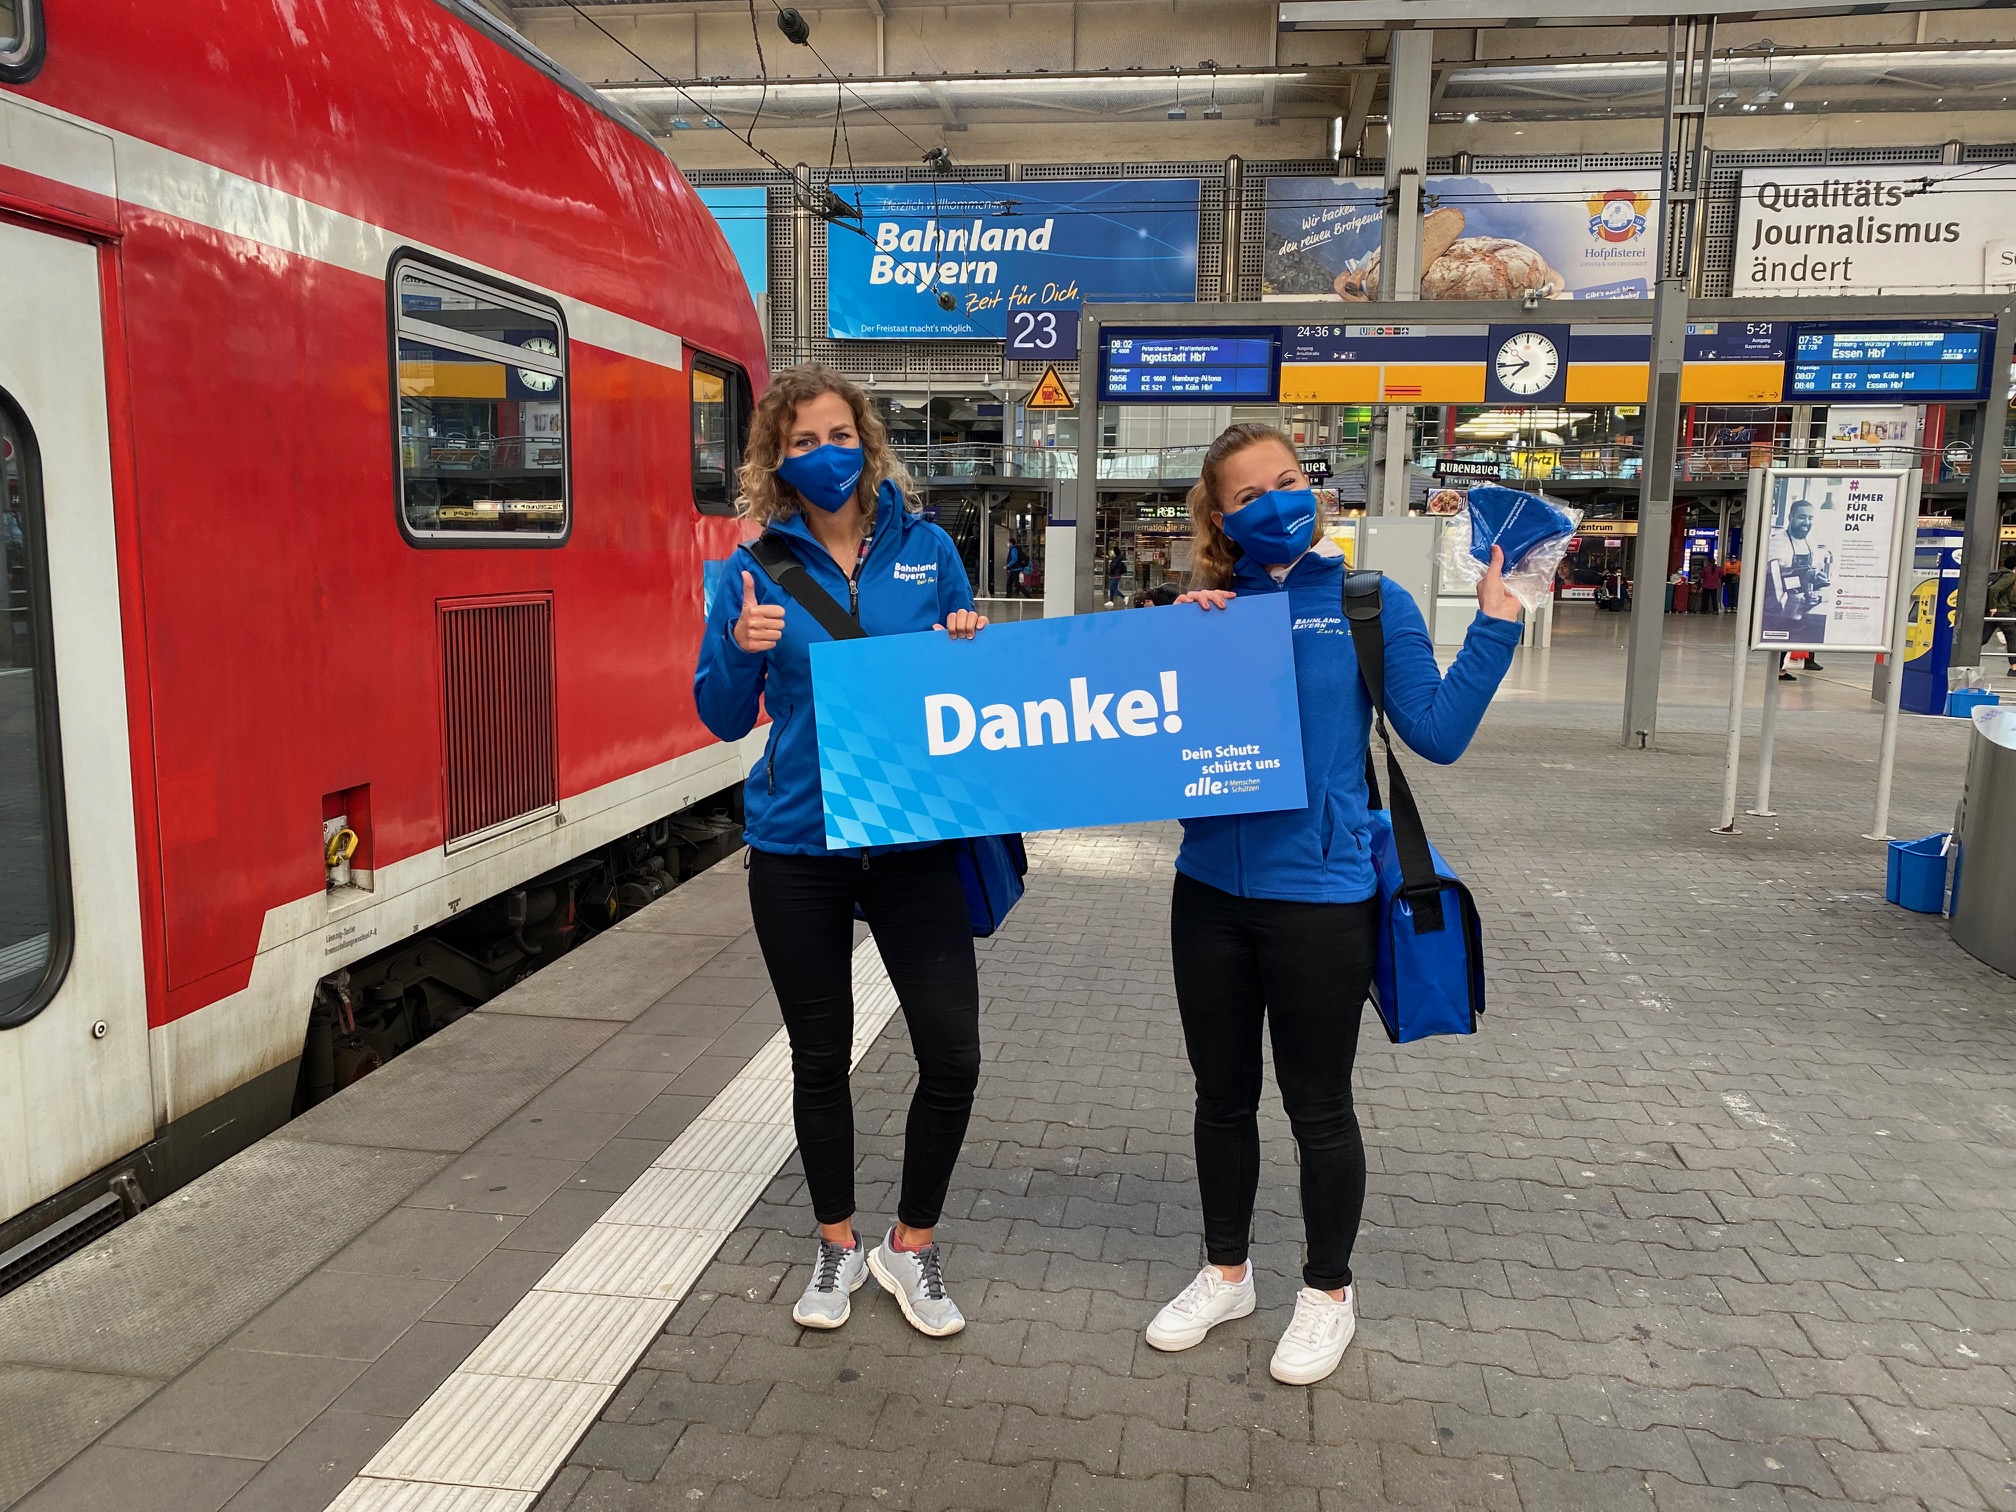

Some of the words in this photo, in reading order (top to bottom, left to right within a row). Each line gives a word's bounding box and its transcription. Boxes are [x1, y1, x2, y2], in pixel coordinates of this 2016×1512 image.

[882, 198, 924, 211] Herzlich
[926, 198, 991, 211] willkommen
[1302, 213, 1321, 230] Wir
[1322, 203, 1356, 223] backen
[874, 218, 1055, 253] Bahnland
[1752, 216, 1961, 250] Journalismus
[1278, 240, 1299, 256] den
[1300, 230, 1332, 248] reinen
[1585, 248, 1646, 260] Hofpfisterei
[2001, 250, 2016, 266] S
[868, 255, 999, 293] Bayern
[1751, 254, 1853, 283] ändert
[965, 290, 1003, 313] Zeit
[1007, 284, 1037, 311] für
[1041, 280, 1080, 305] Dich.
[861, 324, 875, 333] Der
[876, 323, 908, 333] Freistaat
[909, 323, 939, 333] macht's
[940, 323, 974, 335] möglich.
[1013, 312, 1058, 349] 23
[1297, 326, 1329, 337] 24-36
[1746, 323, 1773, 335] 5-21
[1111, 340, 1133, 349] 08:02
[1798, 335, 1823, 345] 07:52
[1141, 352, 1187, 364] Ingolstadt
[1190, 351, 1206, 362] Hbf
[1832, 349, 1863, 359] Essen
[1868, 347, 1886, 358] Hbf
[1172, 375, 1222, 384] Hamburg-Altona
[1795, 372, 1816, 380] 08:07
[1883, 371, 1899, 379] Köln
[1901, 371, 1915, 379] Hbf
[1890, 381, 1904, 389] Hbf
[1848, 493, 1884, 502] IMMER
[1847, 501, 1868, 512] FÜR
[1845, 513, 1875, 522] MICH
[1127, 523, 1178, 532] Internationale
[1844, 523, 1860, 532] DA
[895, 561, 937, 572] Bahnland
[893, 570, 926, 582] Bayern
[1295, 617, 1342, 625] BAHNLAND
[923, 669, 1184, 757] Danke!
[1181, 747, 1213, 761] Dein
[1215, 743, 1260, 758] Schutz
[1201, 759, 1253, 775] schützt
[1255, 758, 1281, 770] uns
[1231, 785, 1260, 793] Schützen
